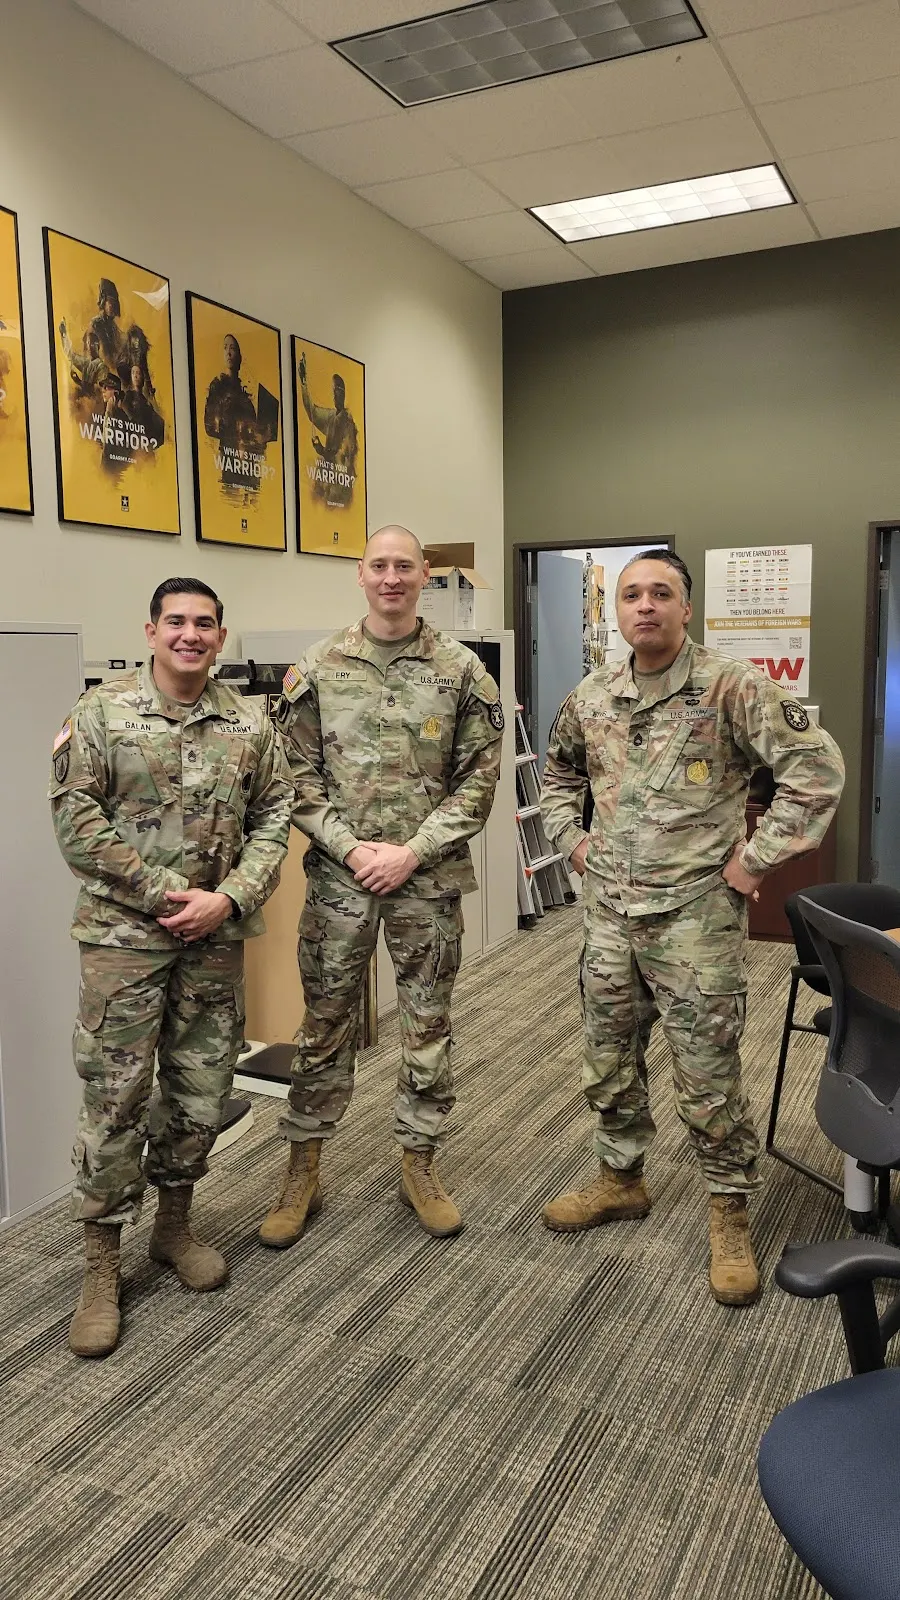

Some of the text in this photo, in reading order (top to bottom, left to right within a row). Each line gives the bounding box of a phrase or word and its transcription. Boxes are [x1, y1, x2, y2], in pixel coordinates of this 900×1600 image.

[92, 413, 146, 434] WHAT'S YOUR
[79, 422, 158, 452] WARRIOR?
[214, 453, 275, 480] WARRIOR?
[249, 452, 266, 464] YOUR
[315, 459, 348, 473] WHAT'S YOUR
[307, 465, 356, 488] WARRIOR?
[335, 671, 351, 680] FRY
[125, 721, 151, 732] GALAN
